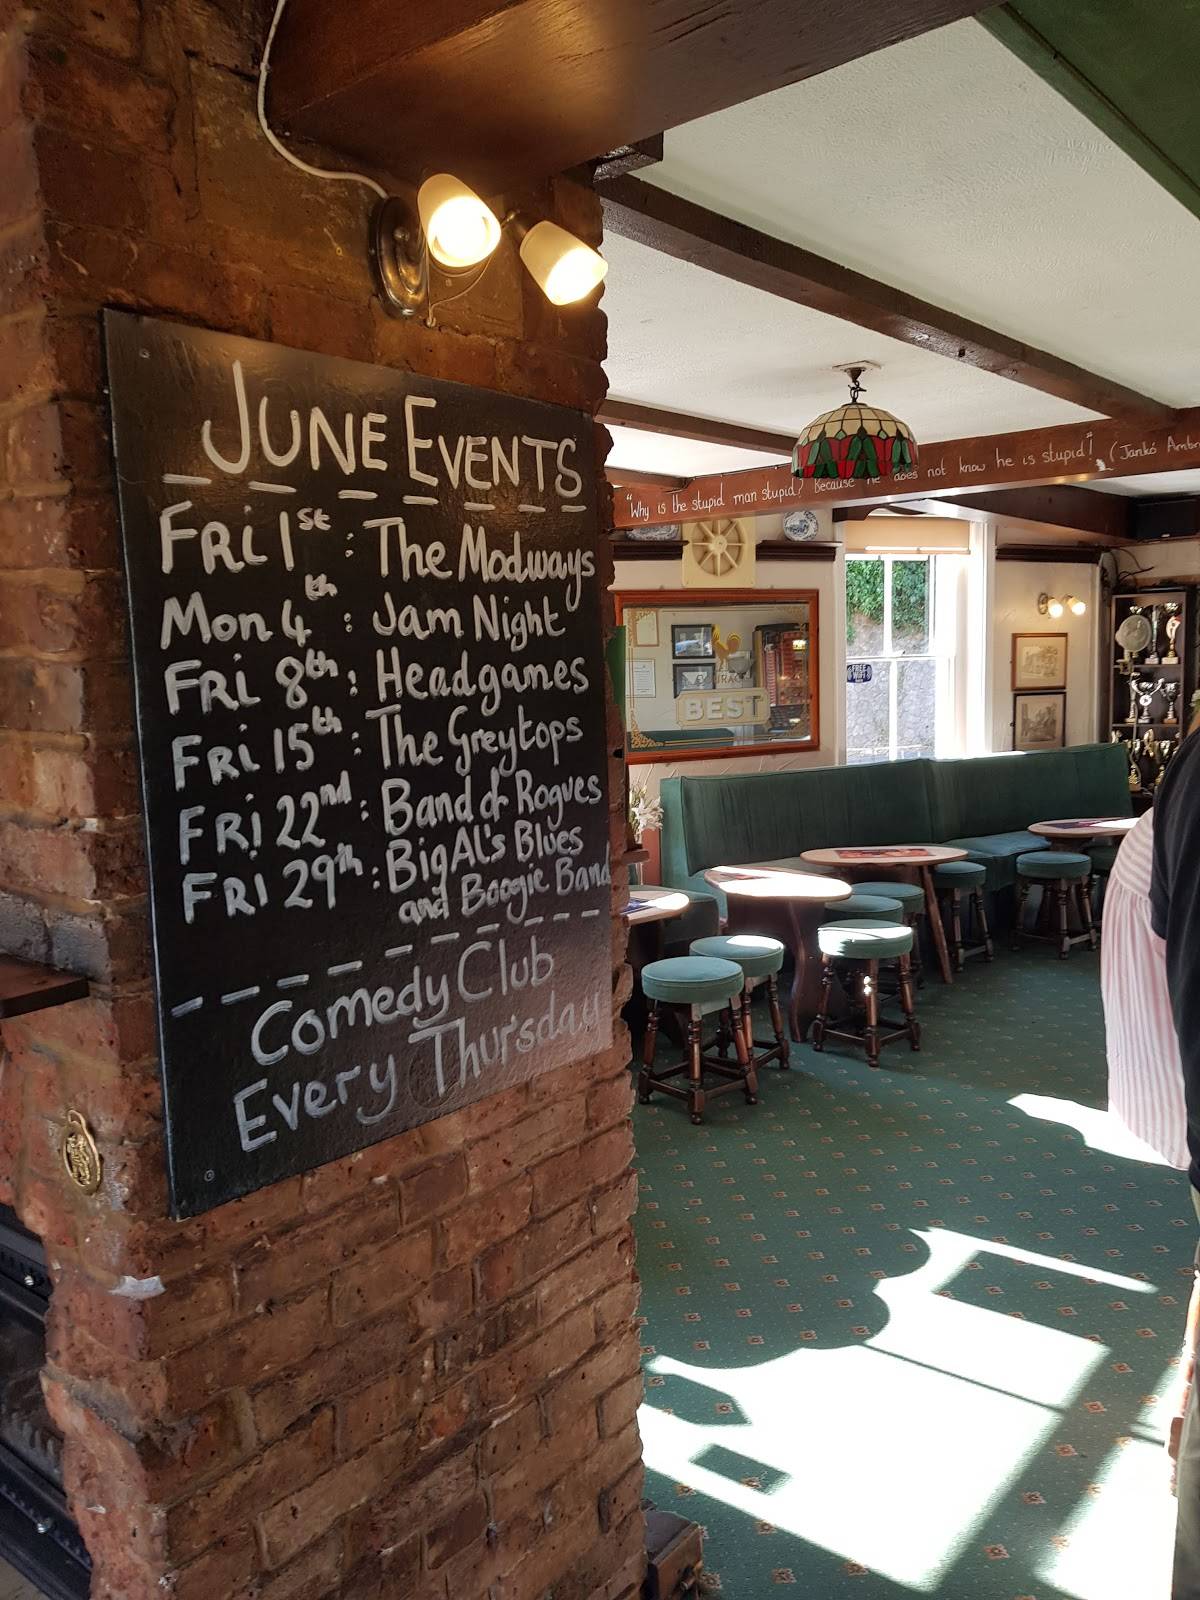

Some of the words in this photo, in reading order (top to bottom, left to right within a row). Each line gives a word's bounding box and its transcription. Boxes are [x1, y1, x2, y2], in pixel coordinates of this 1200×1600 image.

[202, 359, 389, 474] JUNE
[404, 394, 583, 498] EVENTS
[657, 503, 667, 514] is
[672, 494, 687, 513] the
[691, 482, 725, 512] stupid
[733, 492, 758, 505] man
[927, 457, 946, 478] not
[959, 455, 986, 474] know
[995, 447, 1014, 469] he
[1023, 454, 1036, 465] is
[362, 516, 453, 582] The
[458, 523, 596, 612] Modways
[160, 591, 273, 650] Mon
[372, 591, 464, 641] Jam
[473, 593, 566, 652] Night
[376, 646, 589, 716] Headgames
[686, 695, 764, 721] BEST
[365, 703, 444, 770] The
[449, 705, 584, 778] Greytops
[381, 778, 474, 836] Band
[386, 838, 449, 896] Big
[450, 824, 506, 873] Al's
[514, 820, 584, 863] Blues
[399, 897, 450, 925] and
[461, 862, 550, 924] Boogie
[555, 841, 611, 896] Band
[251, 966, 449, 1066] Comedy
[457, 935, 555, 1003] Club
[234, 1054, 398, 1152] Every
[408, 990, 602, 1098] Thursday
